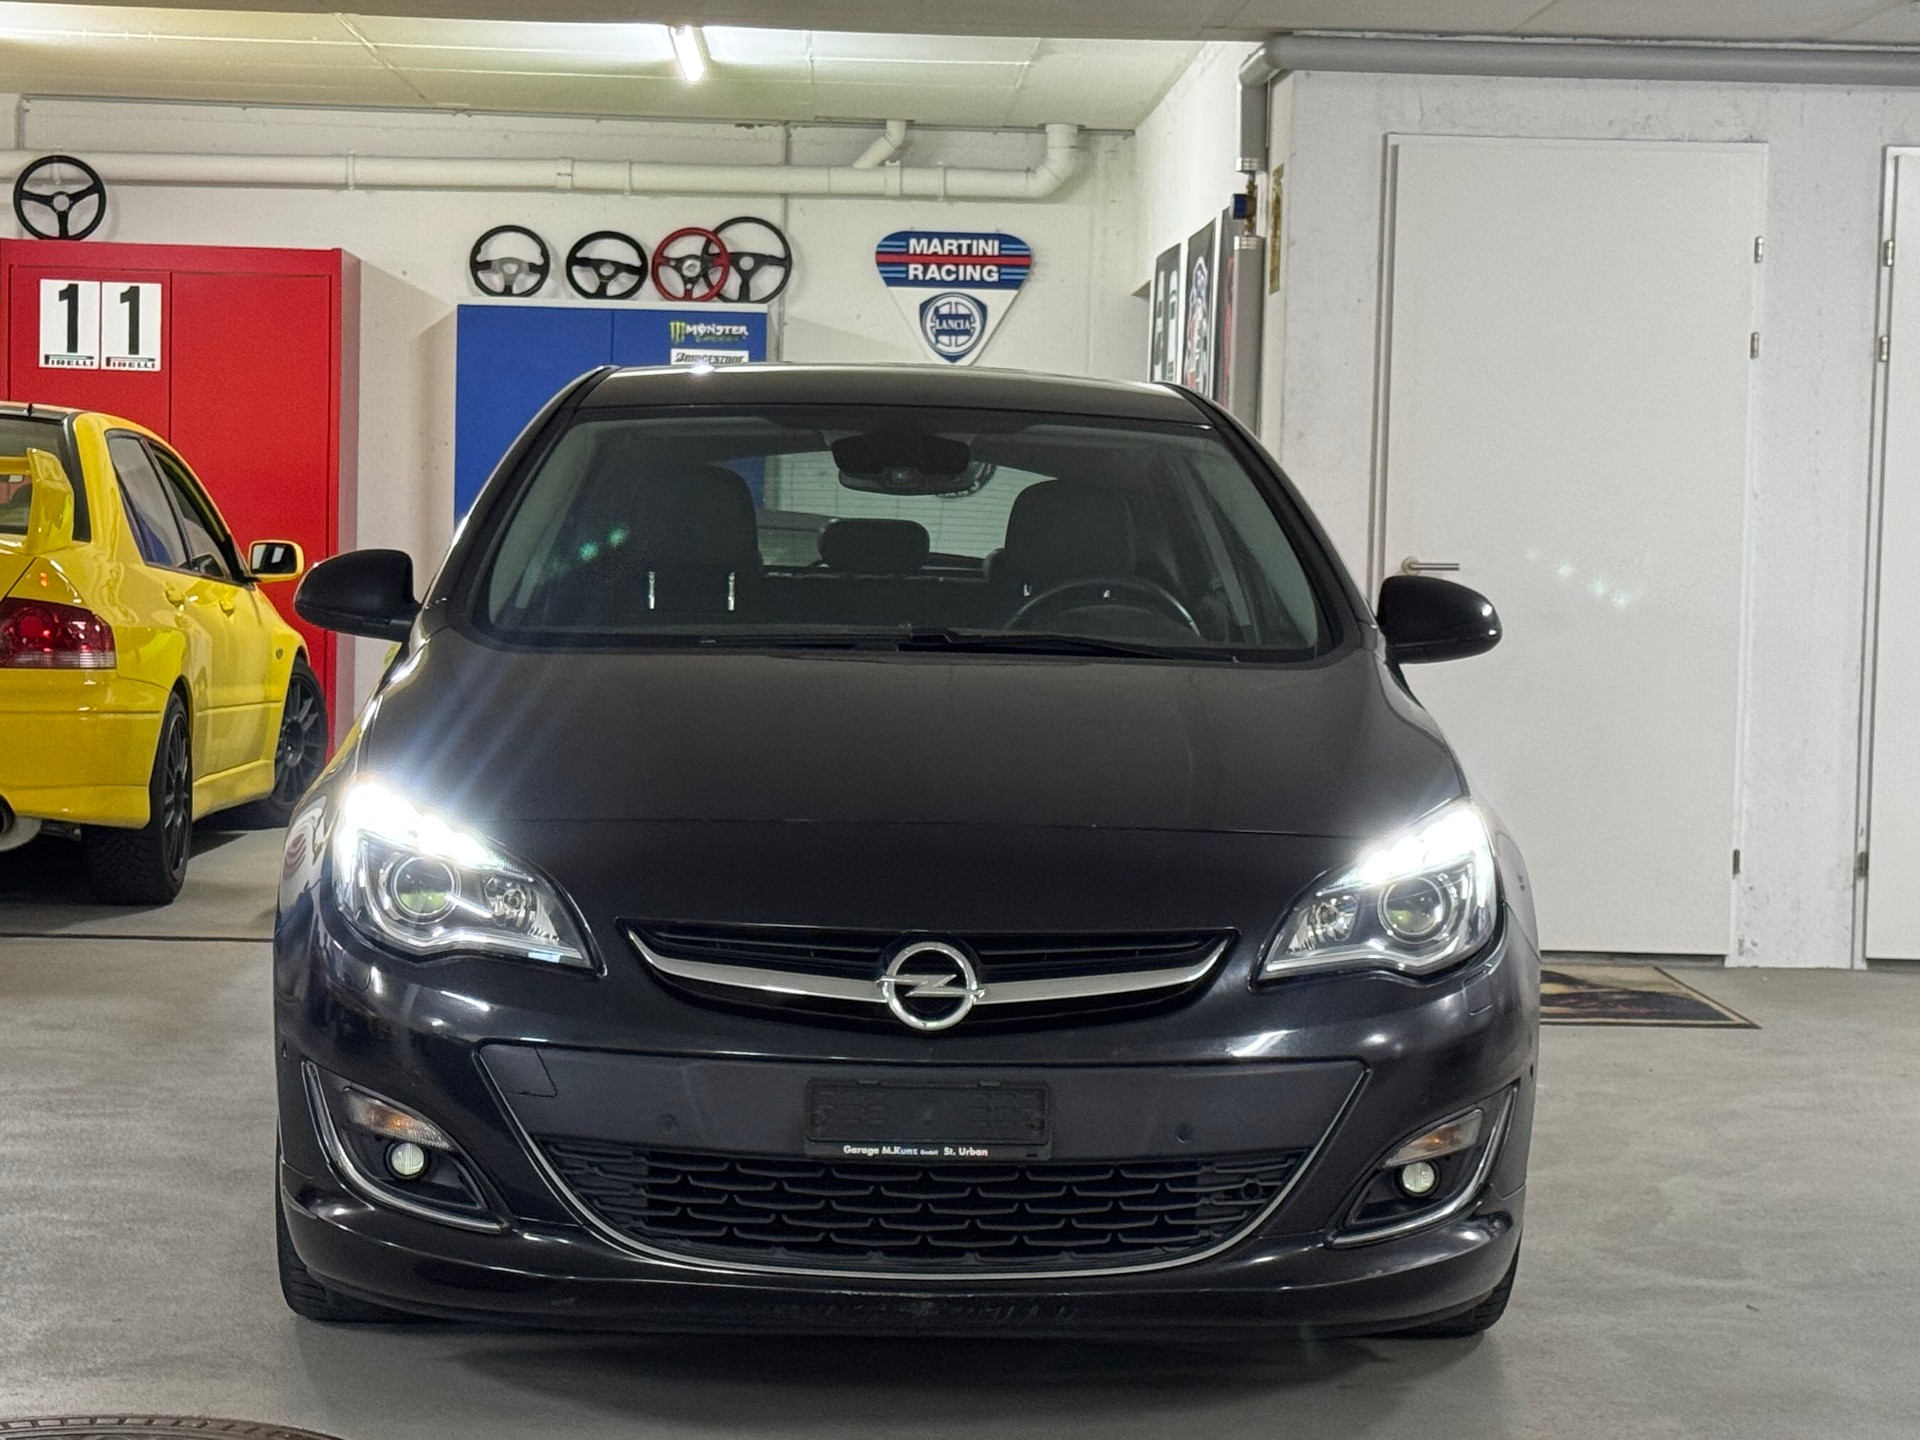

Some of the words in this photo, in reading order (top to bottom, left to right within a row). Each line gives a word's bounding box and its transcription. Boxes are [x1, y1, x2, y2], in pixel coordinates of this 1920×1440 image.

[909, 238, 999, 256] MARTINI
[908, 264, 999, 282] RACING
[686, 324, 749, 336] MONSTER
[935, 319, 971, 331] LANCIA
[843, 1145, 879, 1156] Garage
[943, 1147, 956, 1156] St.
[958, 1147, 988, 1156] Urban
